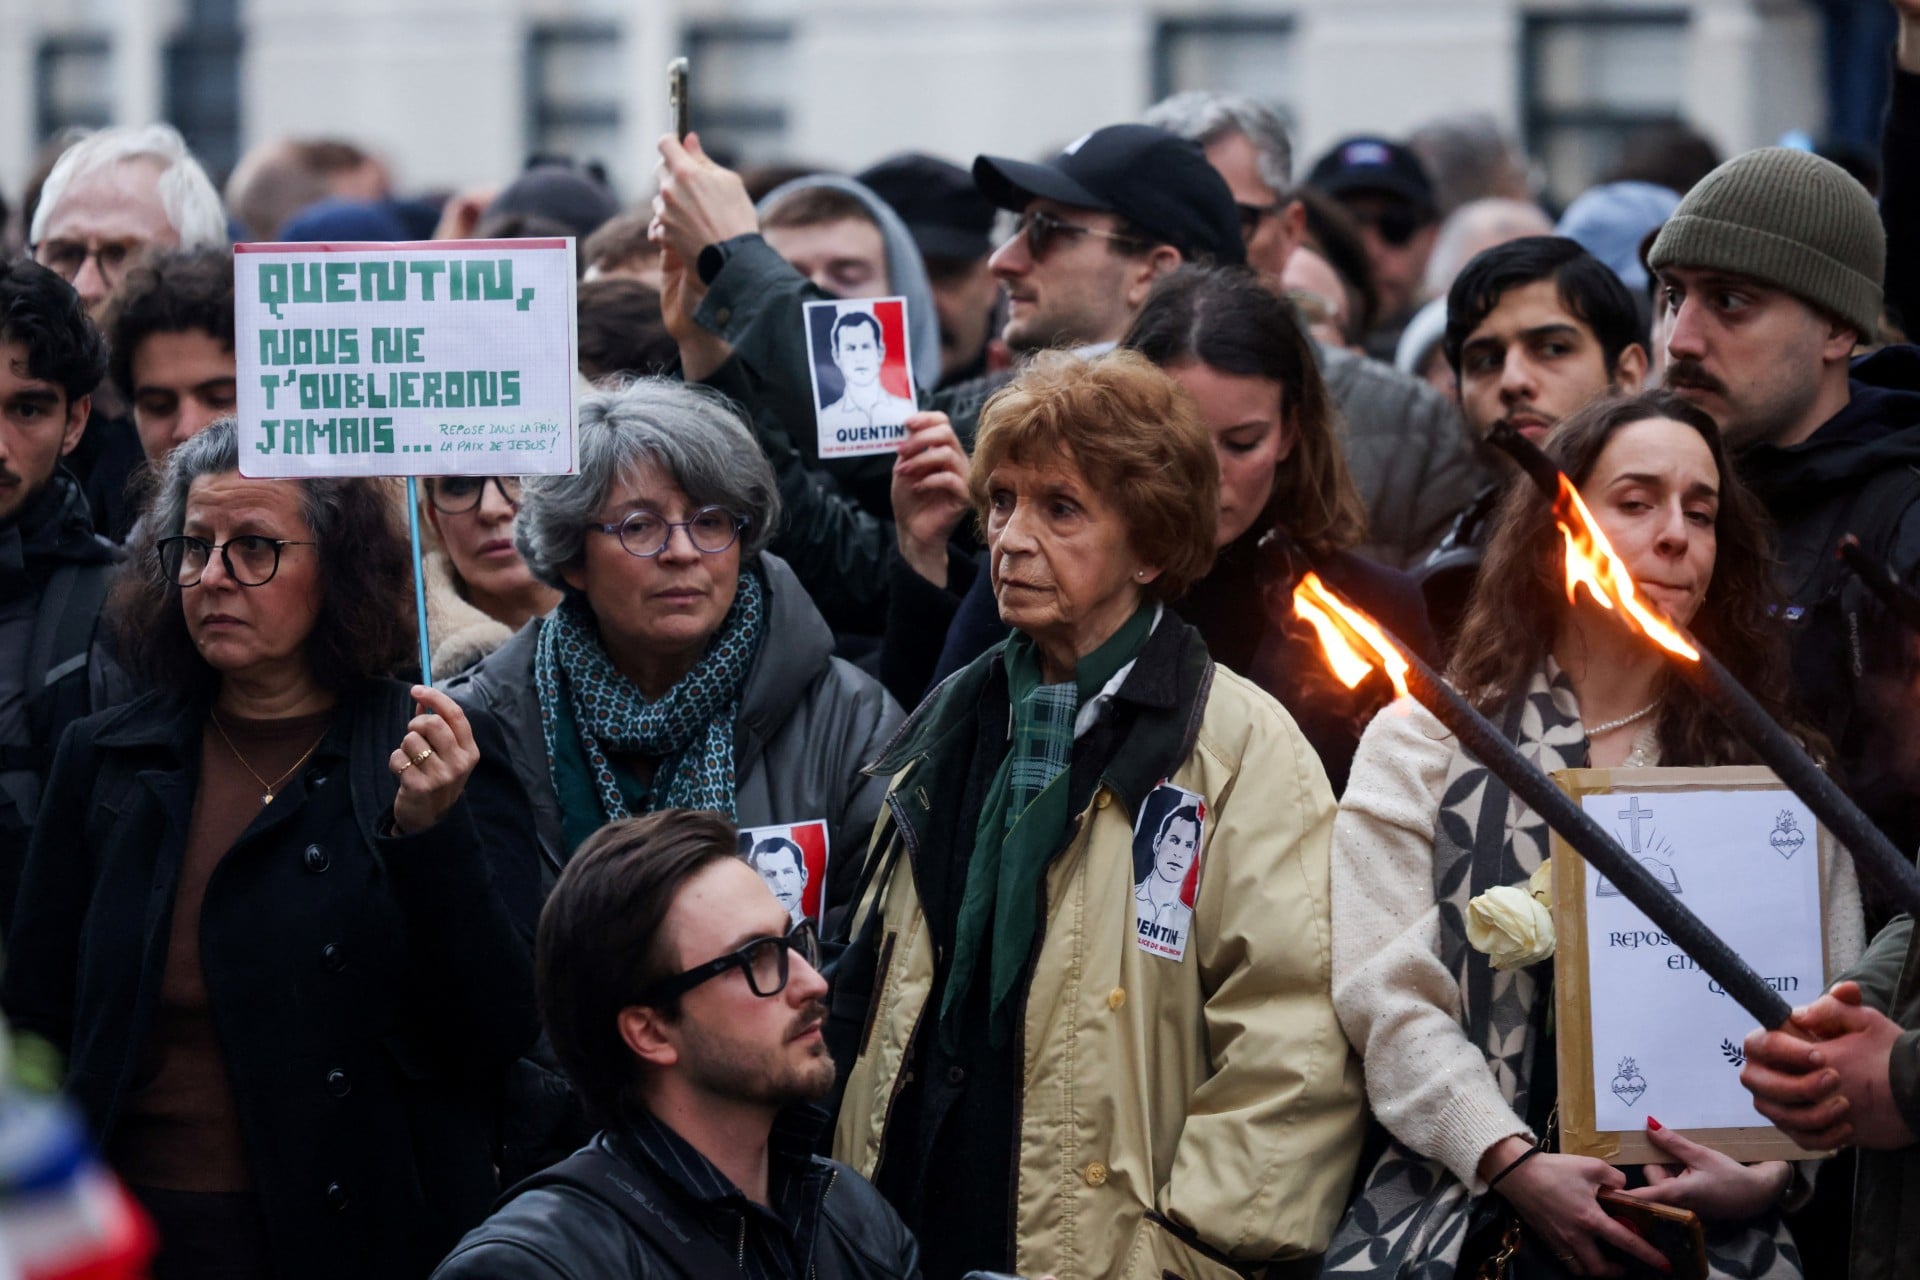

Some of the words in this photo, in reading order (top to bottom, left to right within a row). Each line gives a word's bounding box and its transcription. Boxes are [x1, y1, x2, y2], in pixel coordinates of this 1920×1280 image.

[258, 259, 535, 320] QUENTIN,
[259, 328, 360, 366] NOUS
[371, 327, 426, 364] NE
[259, 369, 521, 410] T'OUBLIERONS
[439, 423, 485, 436] REPOSE
[489, 423, 516, 435] DANS
[520, 424, 531, 433] LA
[836, 424, 905, 442] QUENTIN
[440, 441, 452, 452] LA
[457, 440, 484, 452] PAIX
[489, 441, 504, 452] DE
[1609, 931, 1679, 950] REPOS
[1708, 976, 1799, 996] QTIN
